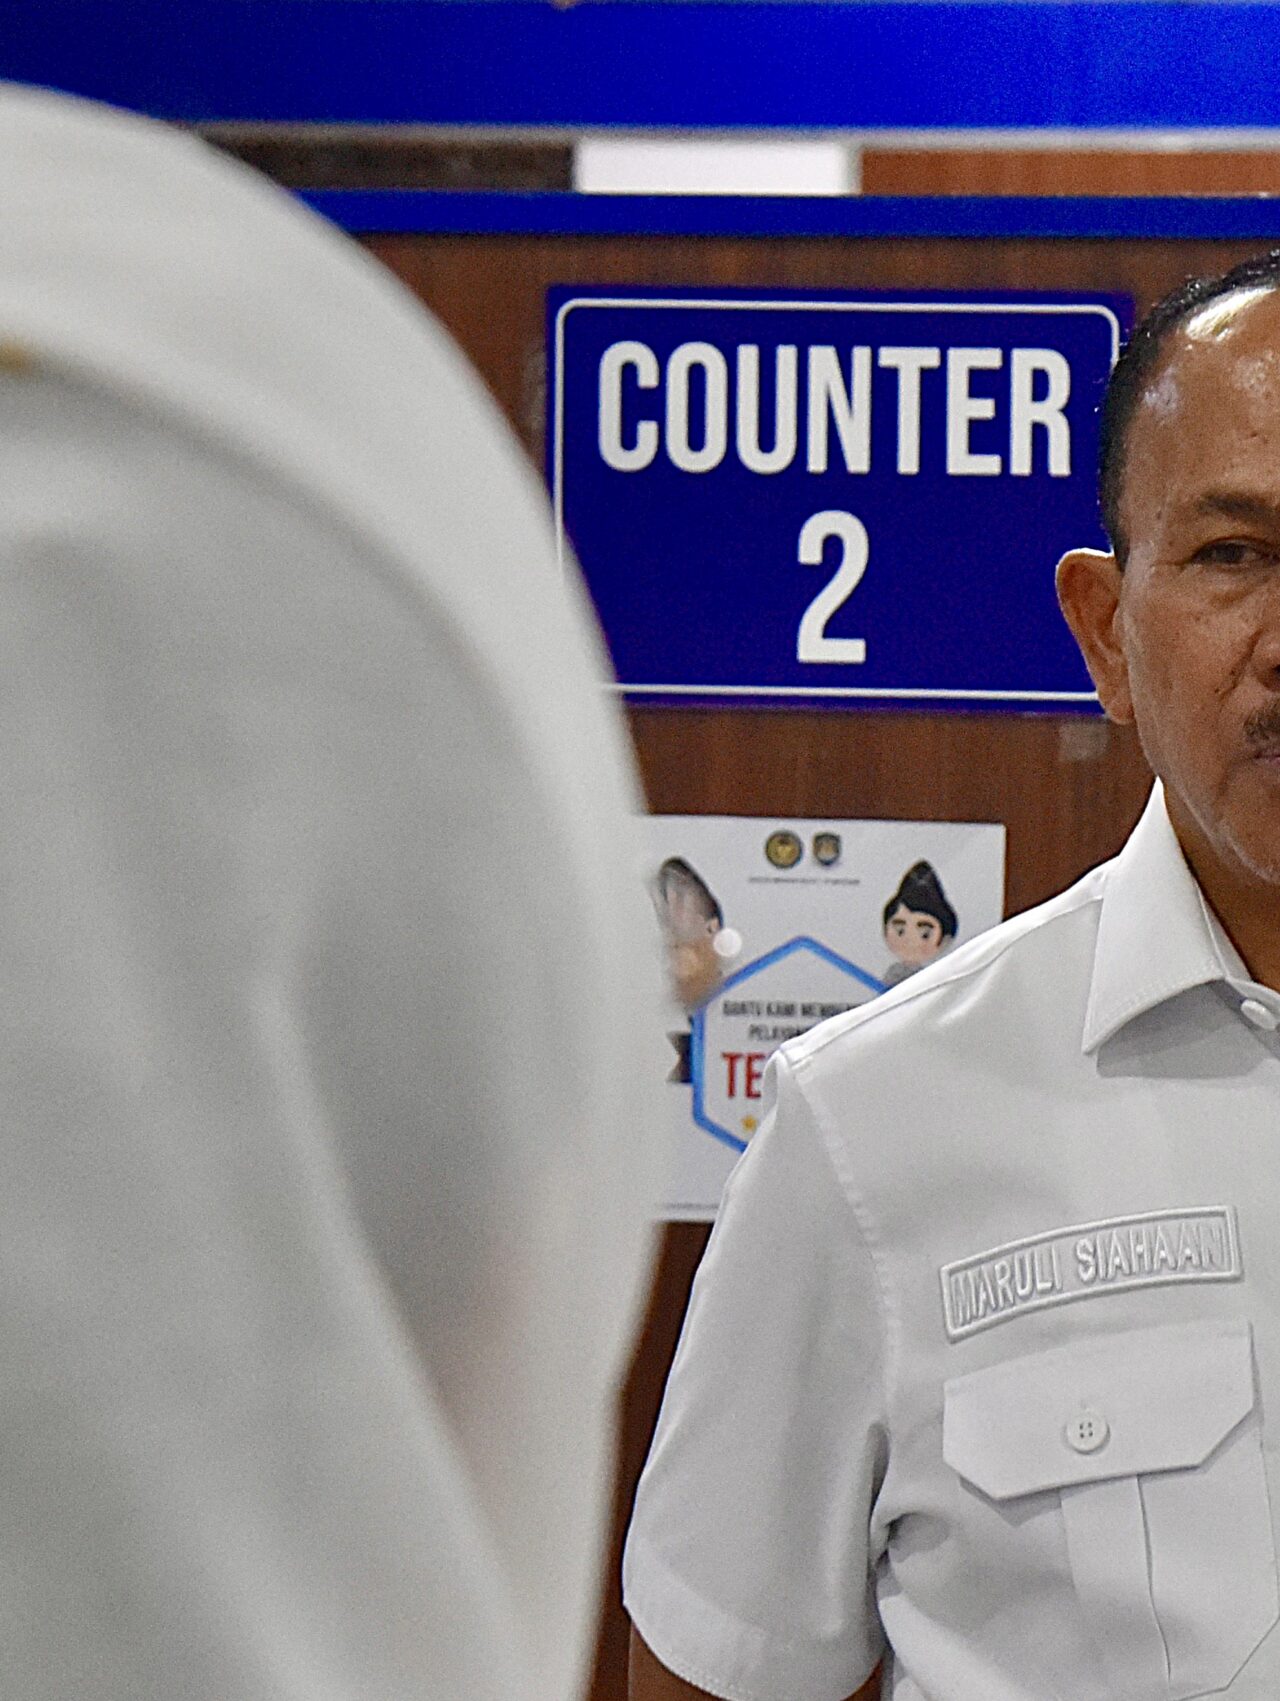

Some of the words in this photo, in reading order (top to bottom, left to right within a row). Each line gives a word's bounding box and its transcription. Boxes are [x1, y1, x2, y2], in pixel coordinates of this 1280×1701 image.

[599, 340, 1071, 477] COUNTER
[797, 510, 869, 663] 2
[722, 1052, 764, 1099] TE
[951, 1246, 1063, 1327] MARULI
[1076, 1222, 1229, 1282] SIAHAAN
